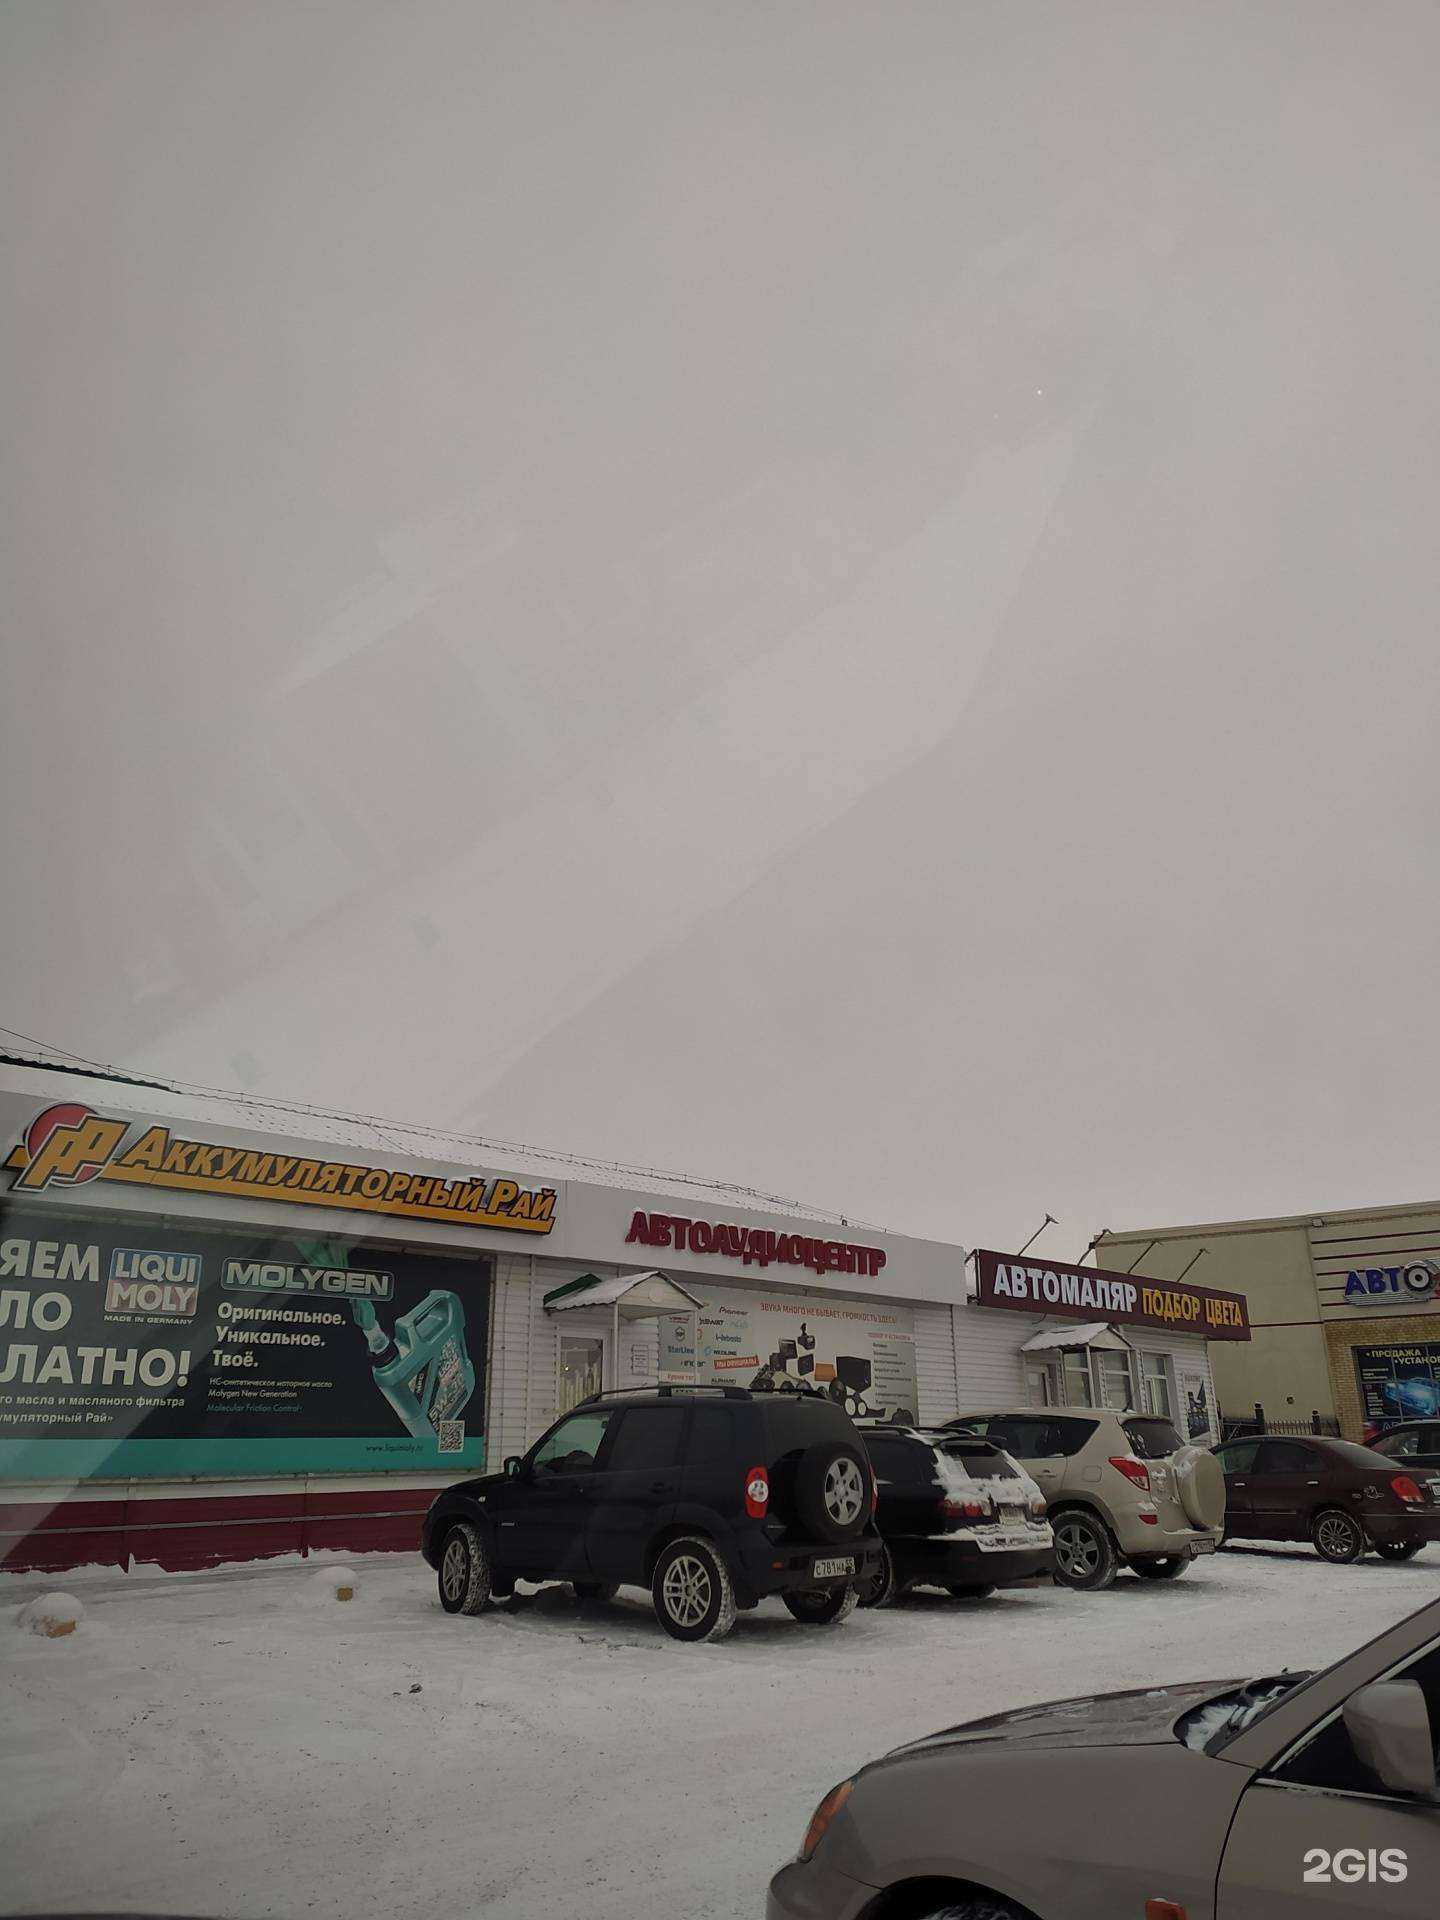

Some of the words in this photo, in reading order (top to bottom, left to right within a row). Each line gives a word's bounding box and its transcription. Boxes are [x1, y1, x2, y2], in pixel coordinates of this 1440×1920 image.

[625, 1211, 887, 1276] АВТОАУДИОЦЕНТР
[0, 1239, 100, 1282] ЯЕМ
[116, 1252, 196, 1284] LIQUI
[226, 1262, 389, 1296] MOLYGEN
[112, 1282, 197, 1312] MOLY
[992, 1263, 1138, 1313] АВТОМАЛЯР
[1142, 1287, 1200, 1323] ПОДБОР
[1204, 1297, 1243, 1328] ЦВЕТА
[104, 1315, 131, 1323] MADE
[147, 1317, 194, 1325] GERMANY
[217, 1302, 347, 1326] Оригинальное.
[215, 1325, 326, 1347] Уникальное.
[0, 1344, 191, 1388] ЛАТНО!
[212, 1349, 259, 1368] Твоё.
[1371, 1349, 1421, 1358] ПРОДАЖА
[16, 1395, 55, 1406] масла
[58, 1397, 65, 1405] и
[67, 1396, 133, 1407] масляного
[135, 1396, 185, 1408] фильтра
[208, 1388, 240, 1400] Molygen
[241, 1389, 259, 1398] New
[259, 1390, 298, 1399] Generation
